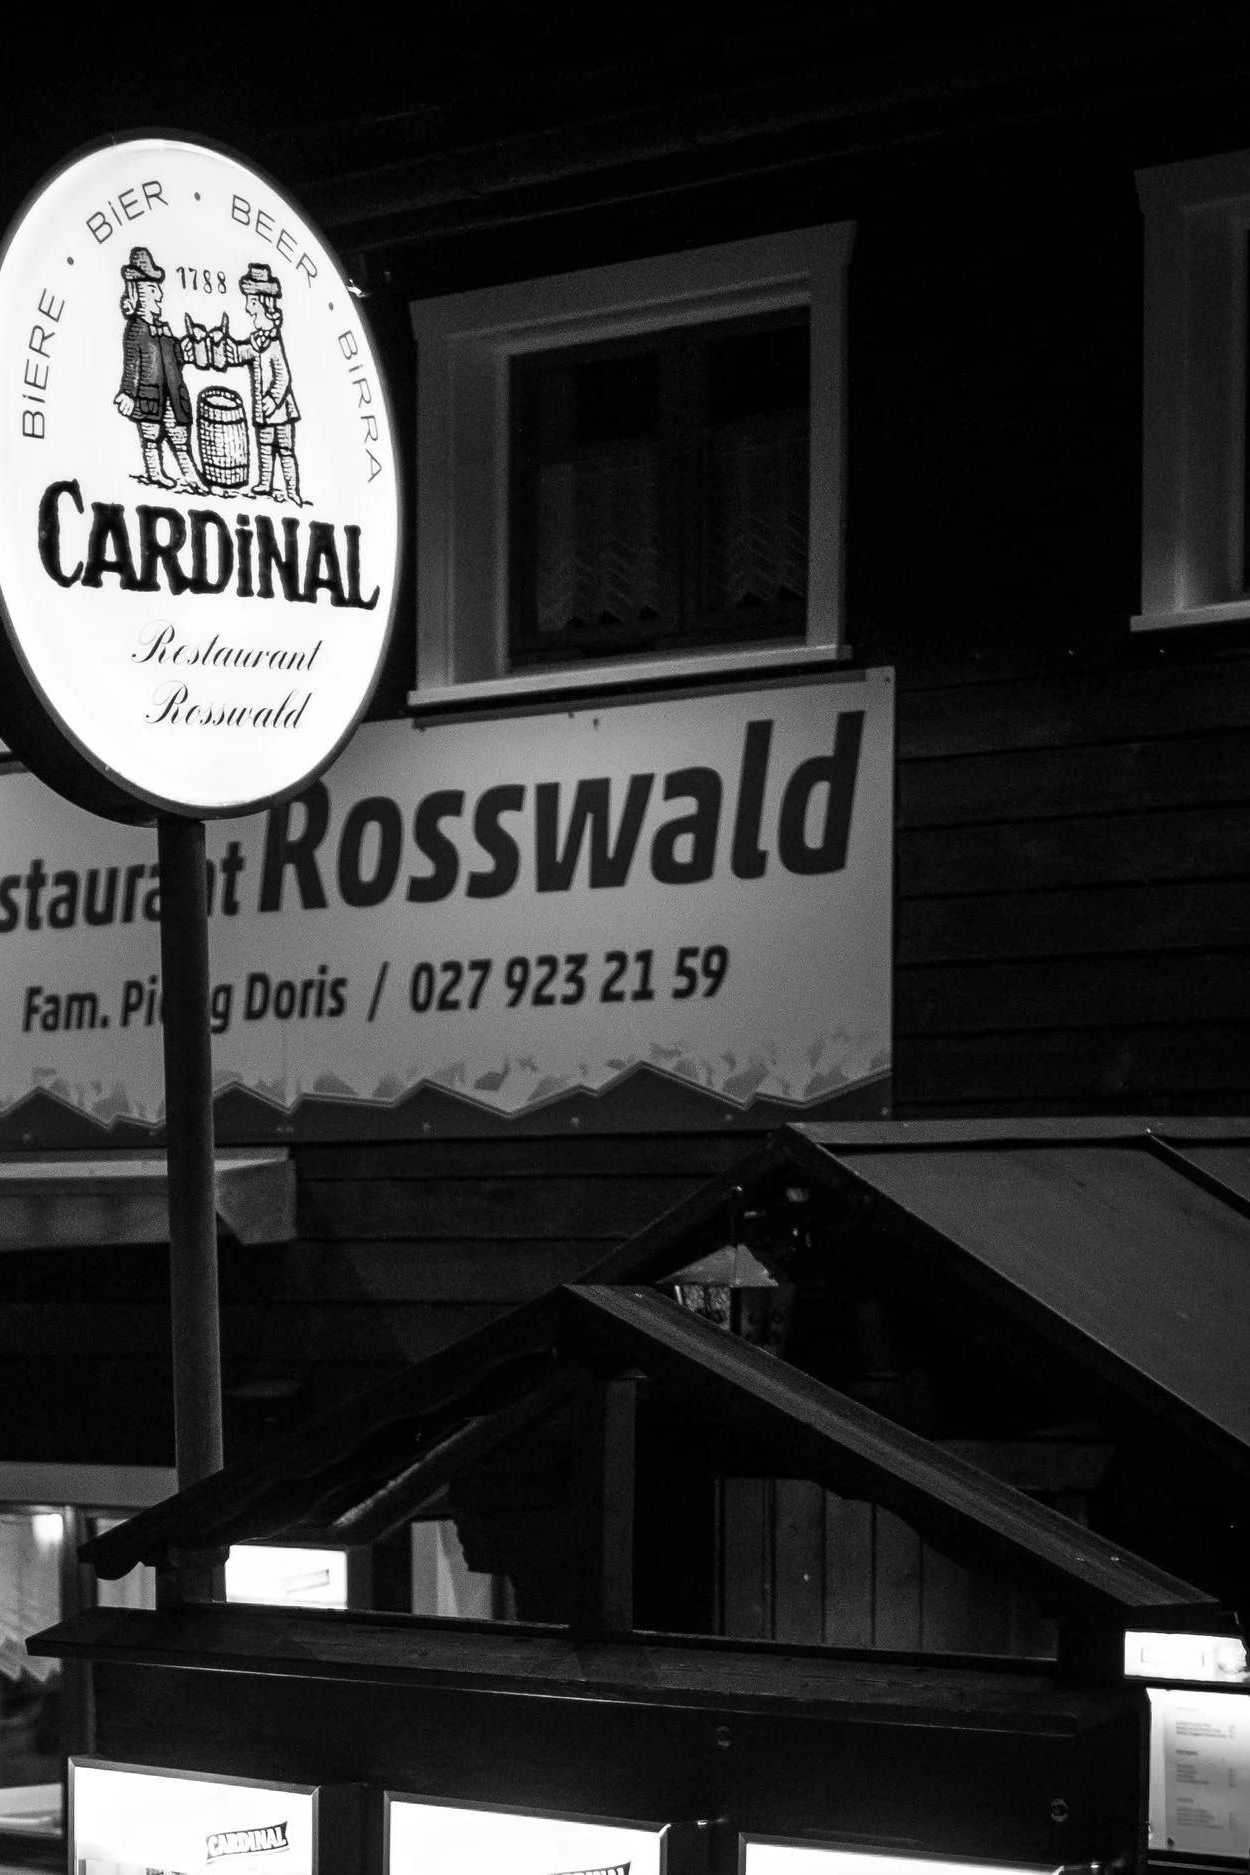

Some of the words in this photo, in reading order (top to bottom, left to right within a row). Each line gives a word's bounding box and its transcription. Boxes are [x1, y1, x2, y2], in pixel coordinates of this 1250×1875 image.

[230, 195, 319, 288] BEER
[176, 265, 227, 295] 1788
[131, 618, 323, 672] Restaurant
[146, 679, 312, 730] Rosswald
[258, 710, 866, 914] Rosswald
[22, 985, 109, 1034] Fam.
[242, 963, 348, 1021] Doris
[409, 958, 493, 1013] 027
[504, 952, 588, 1008] 923
[600, 949, 654, 1003] 21
[671, 944, 730, 999] 59
